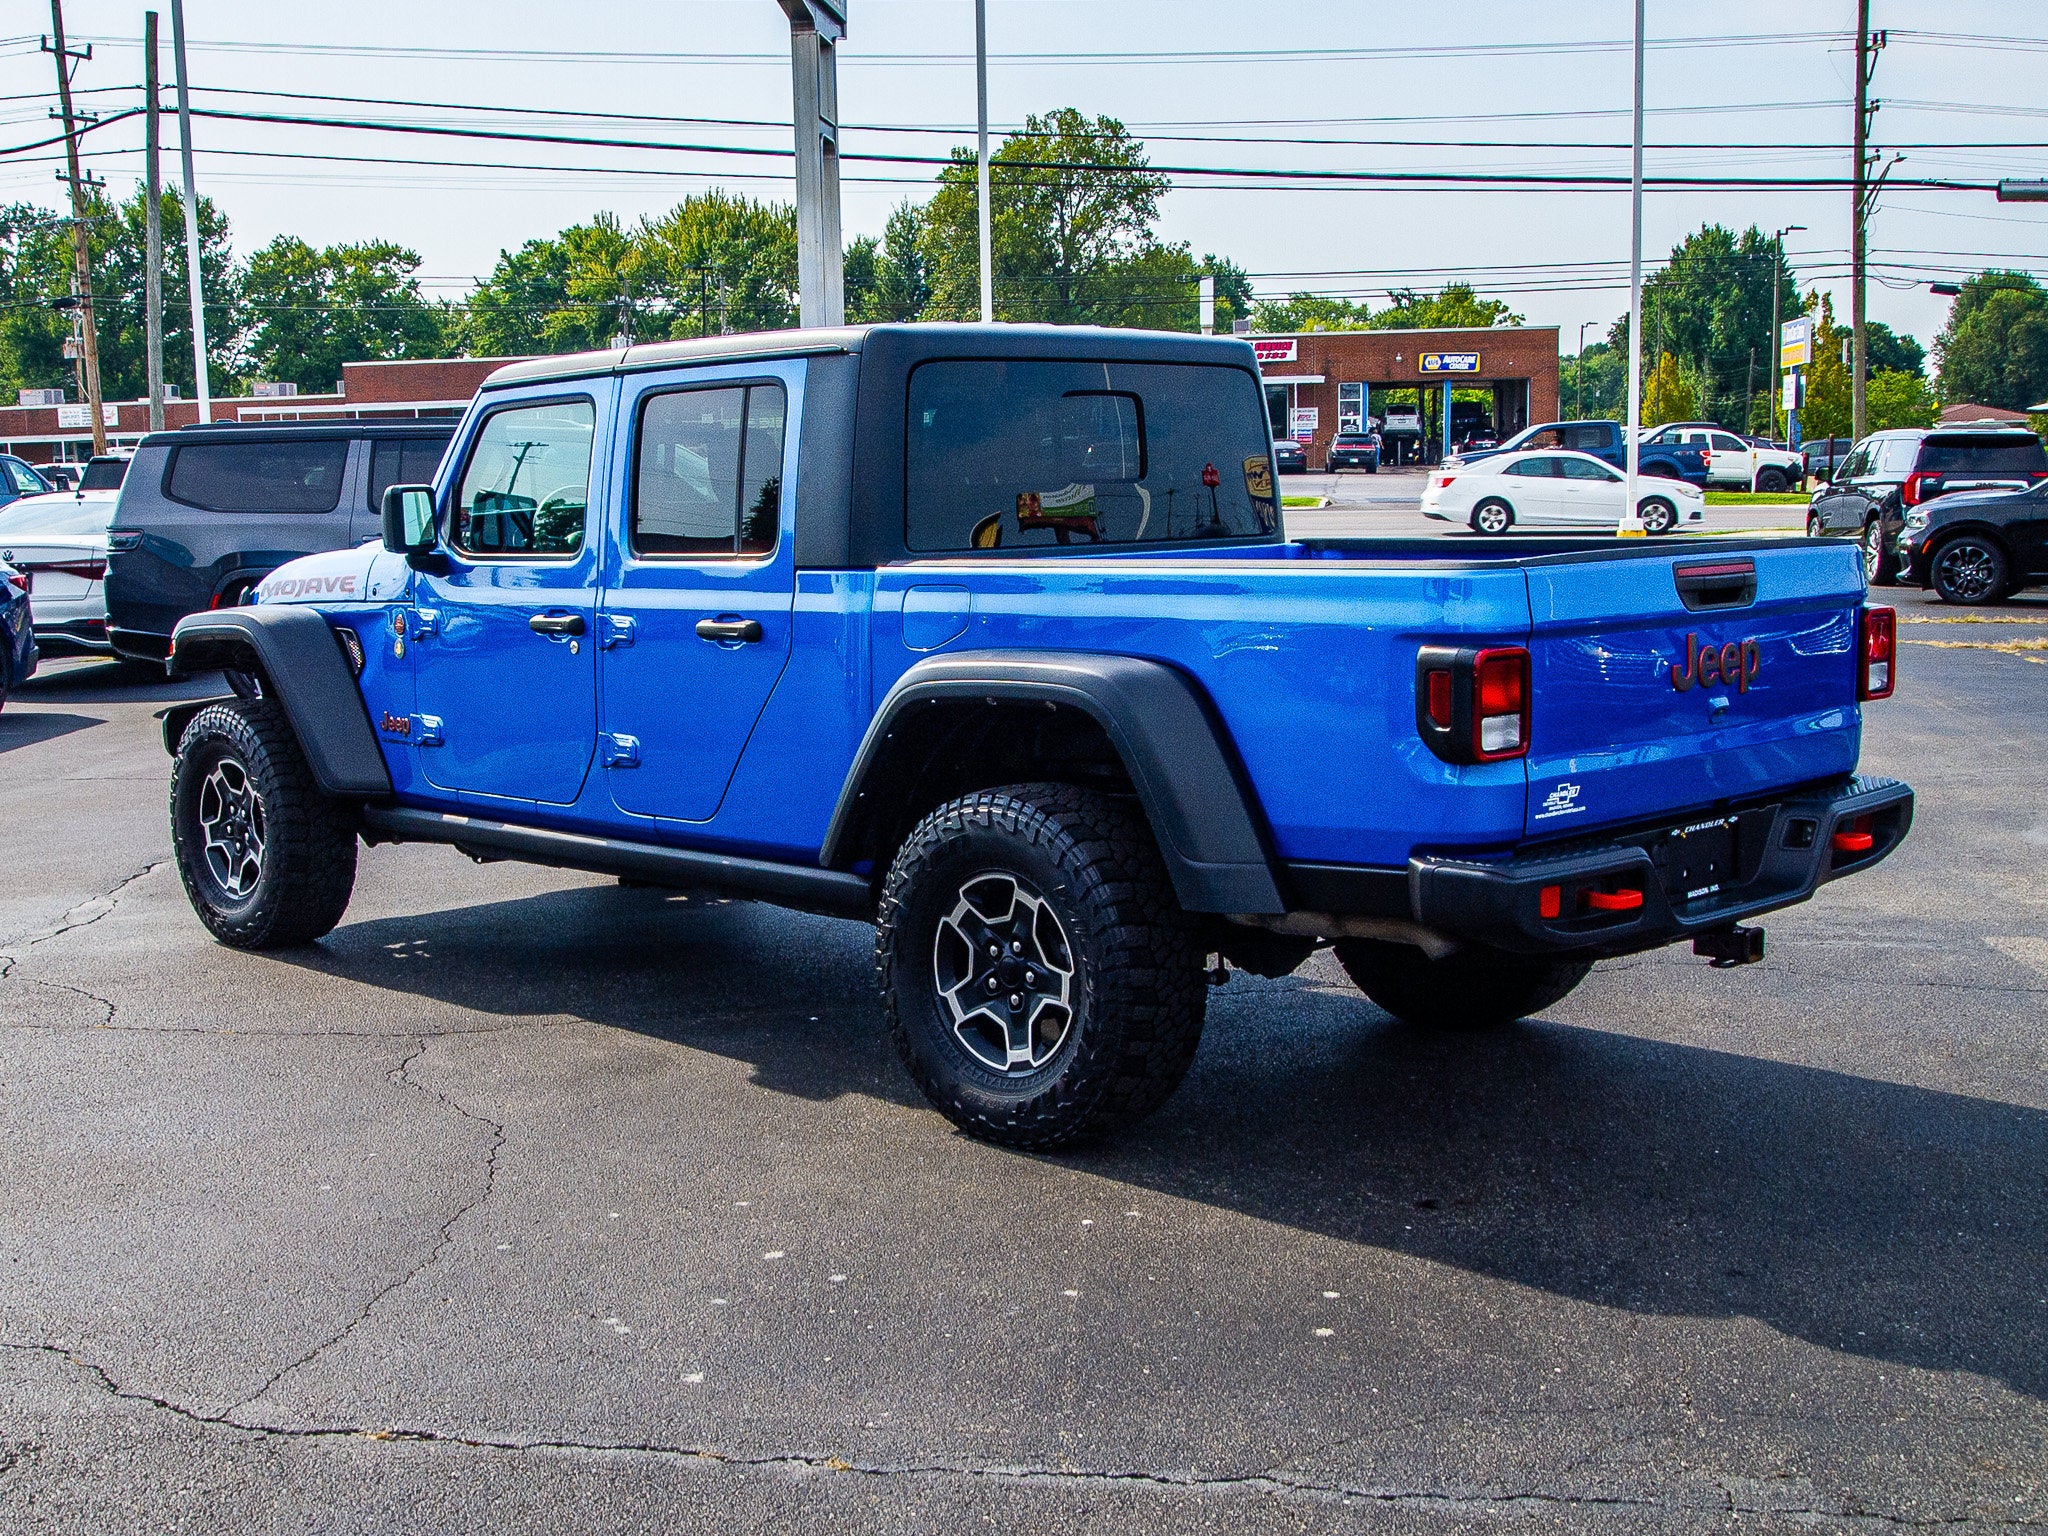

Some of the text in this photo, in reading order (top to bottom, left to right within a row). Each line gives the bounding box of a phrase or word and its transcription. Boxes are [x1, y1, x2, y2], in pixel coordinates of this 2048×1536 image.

[1254, 341, 1293, 351] SERVICE
[261, 575, 356, 598] MOJAVE
[1672, 632, 1760, 694] Jeep
[380, 710, 410, 737] Jeep
[1684, 818, 1725, 833] CHANDLER
